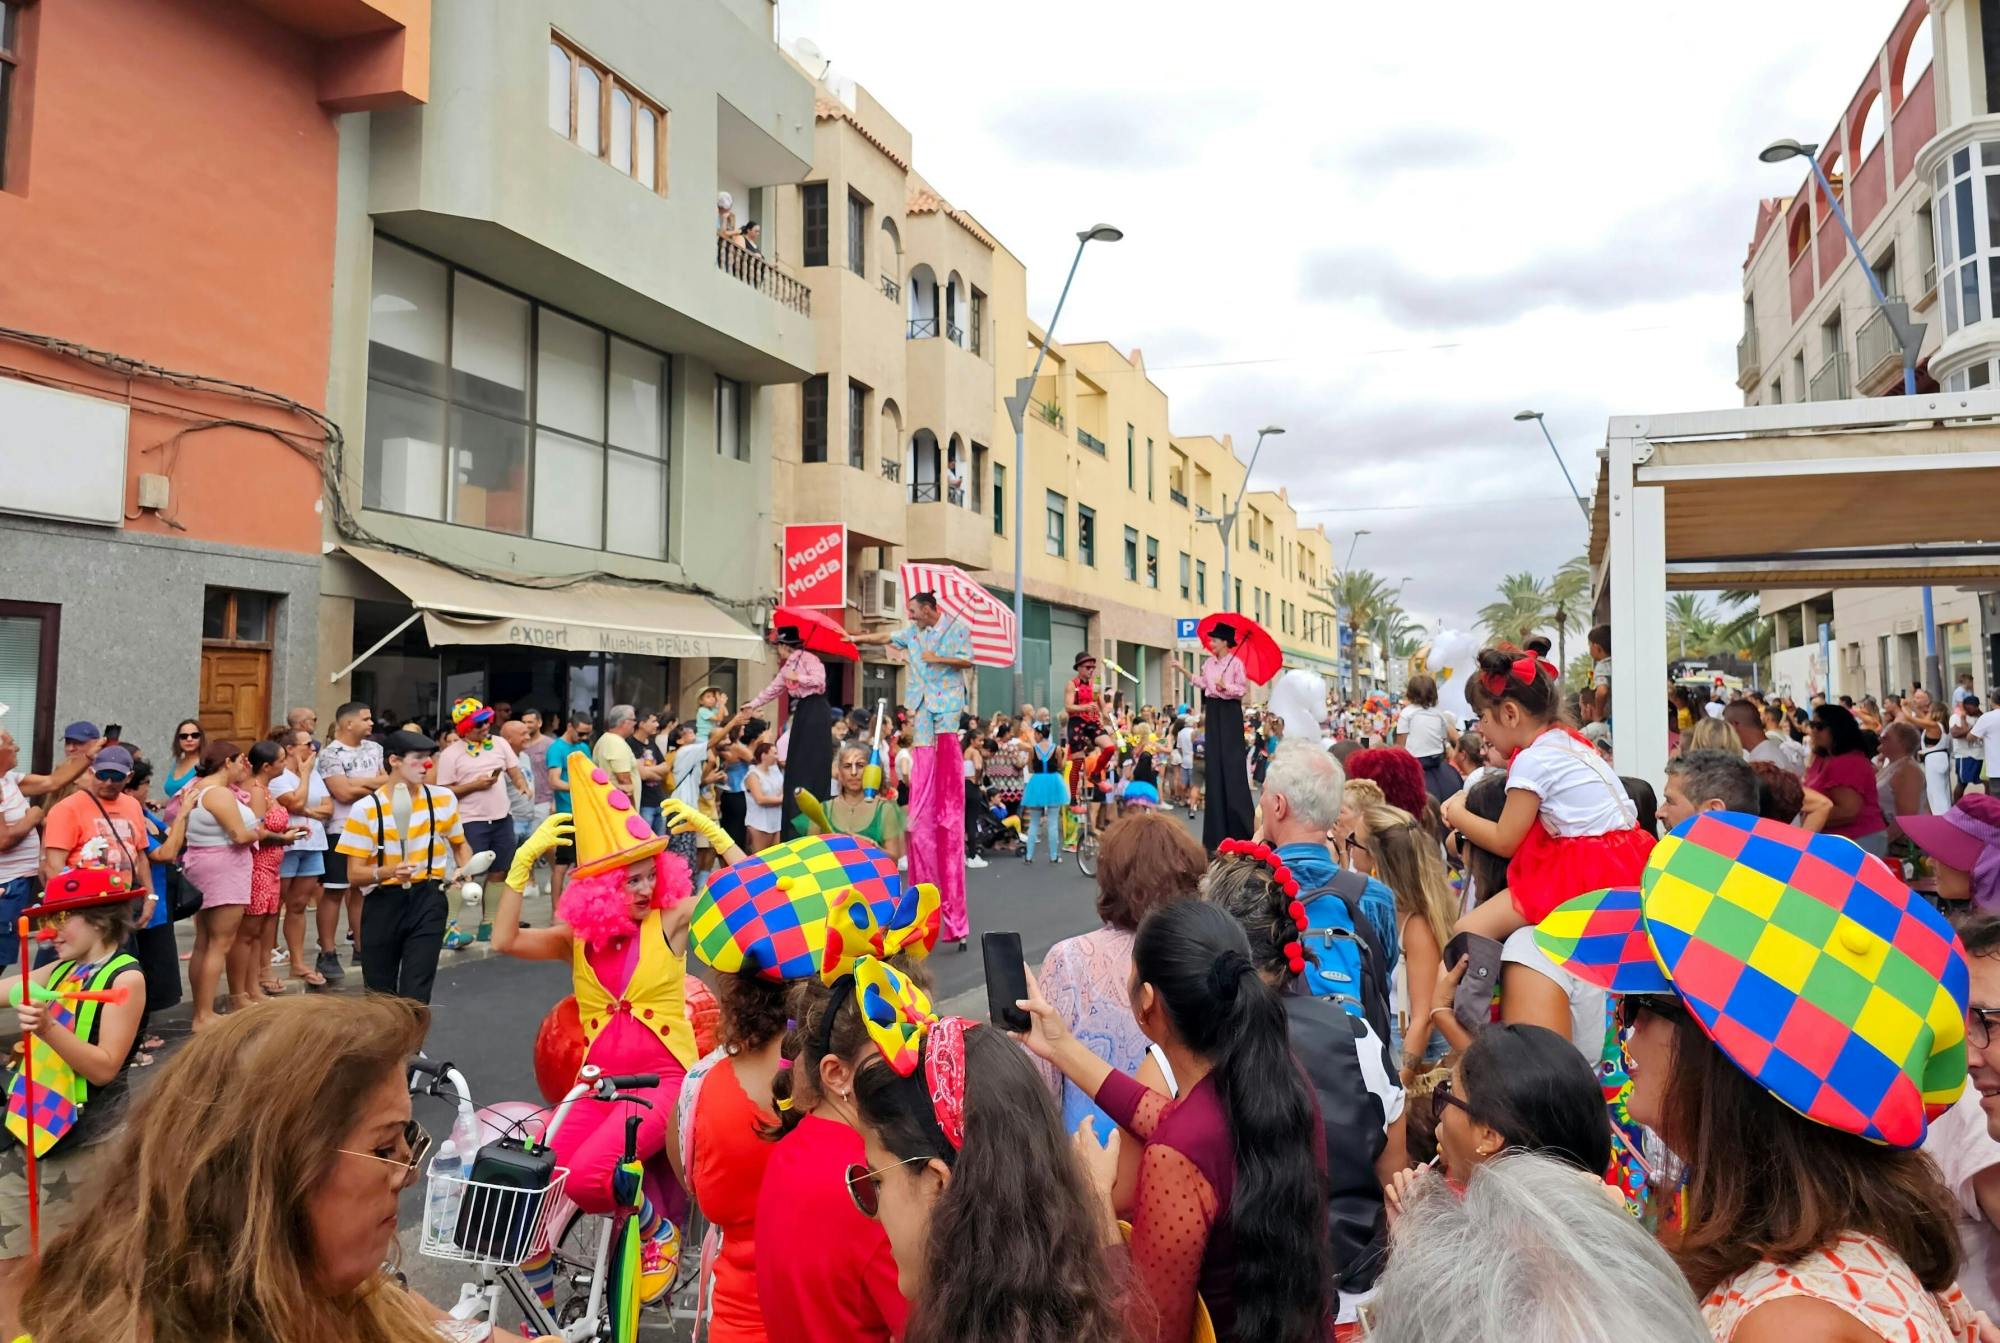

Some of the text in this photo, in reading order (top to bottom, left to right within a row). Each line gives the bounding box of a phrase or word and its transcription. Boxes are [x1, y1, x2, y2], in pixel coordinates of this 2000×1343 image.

[788, 533, 841, 572] Moda
[787, 559, 841, 598] Moda
[510, 625, 569, 647] expert
[1183, 621, 1195, 636] P
[600, 632, 653, 654] Muebles
